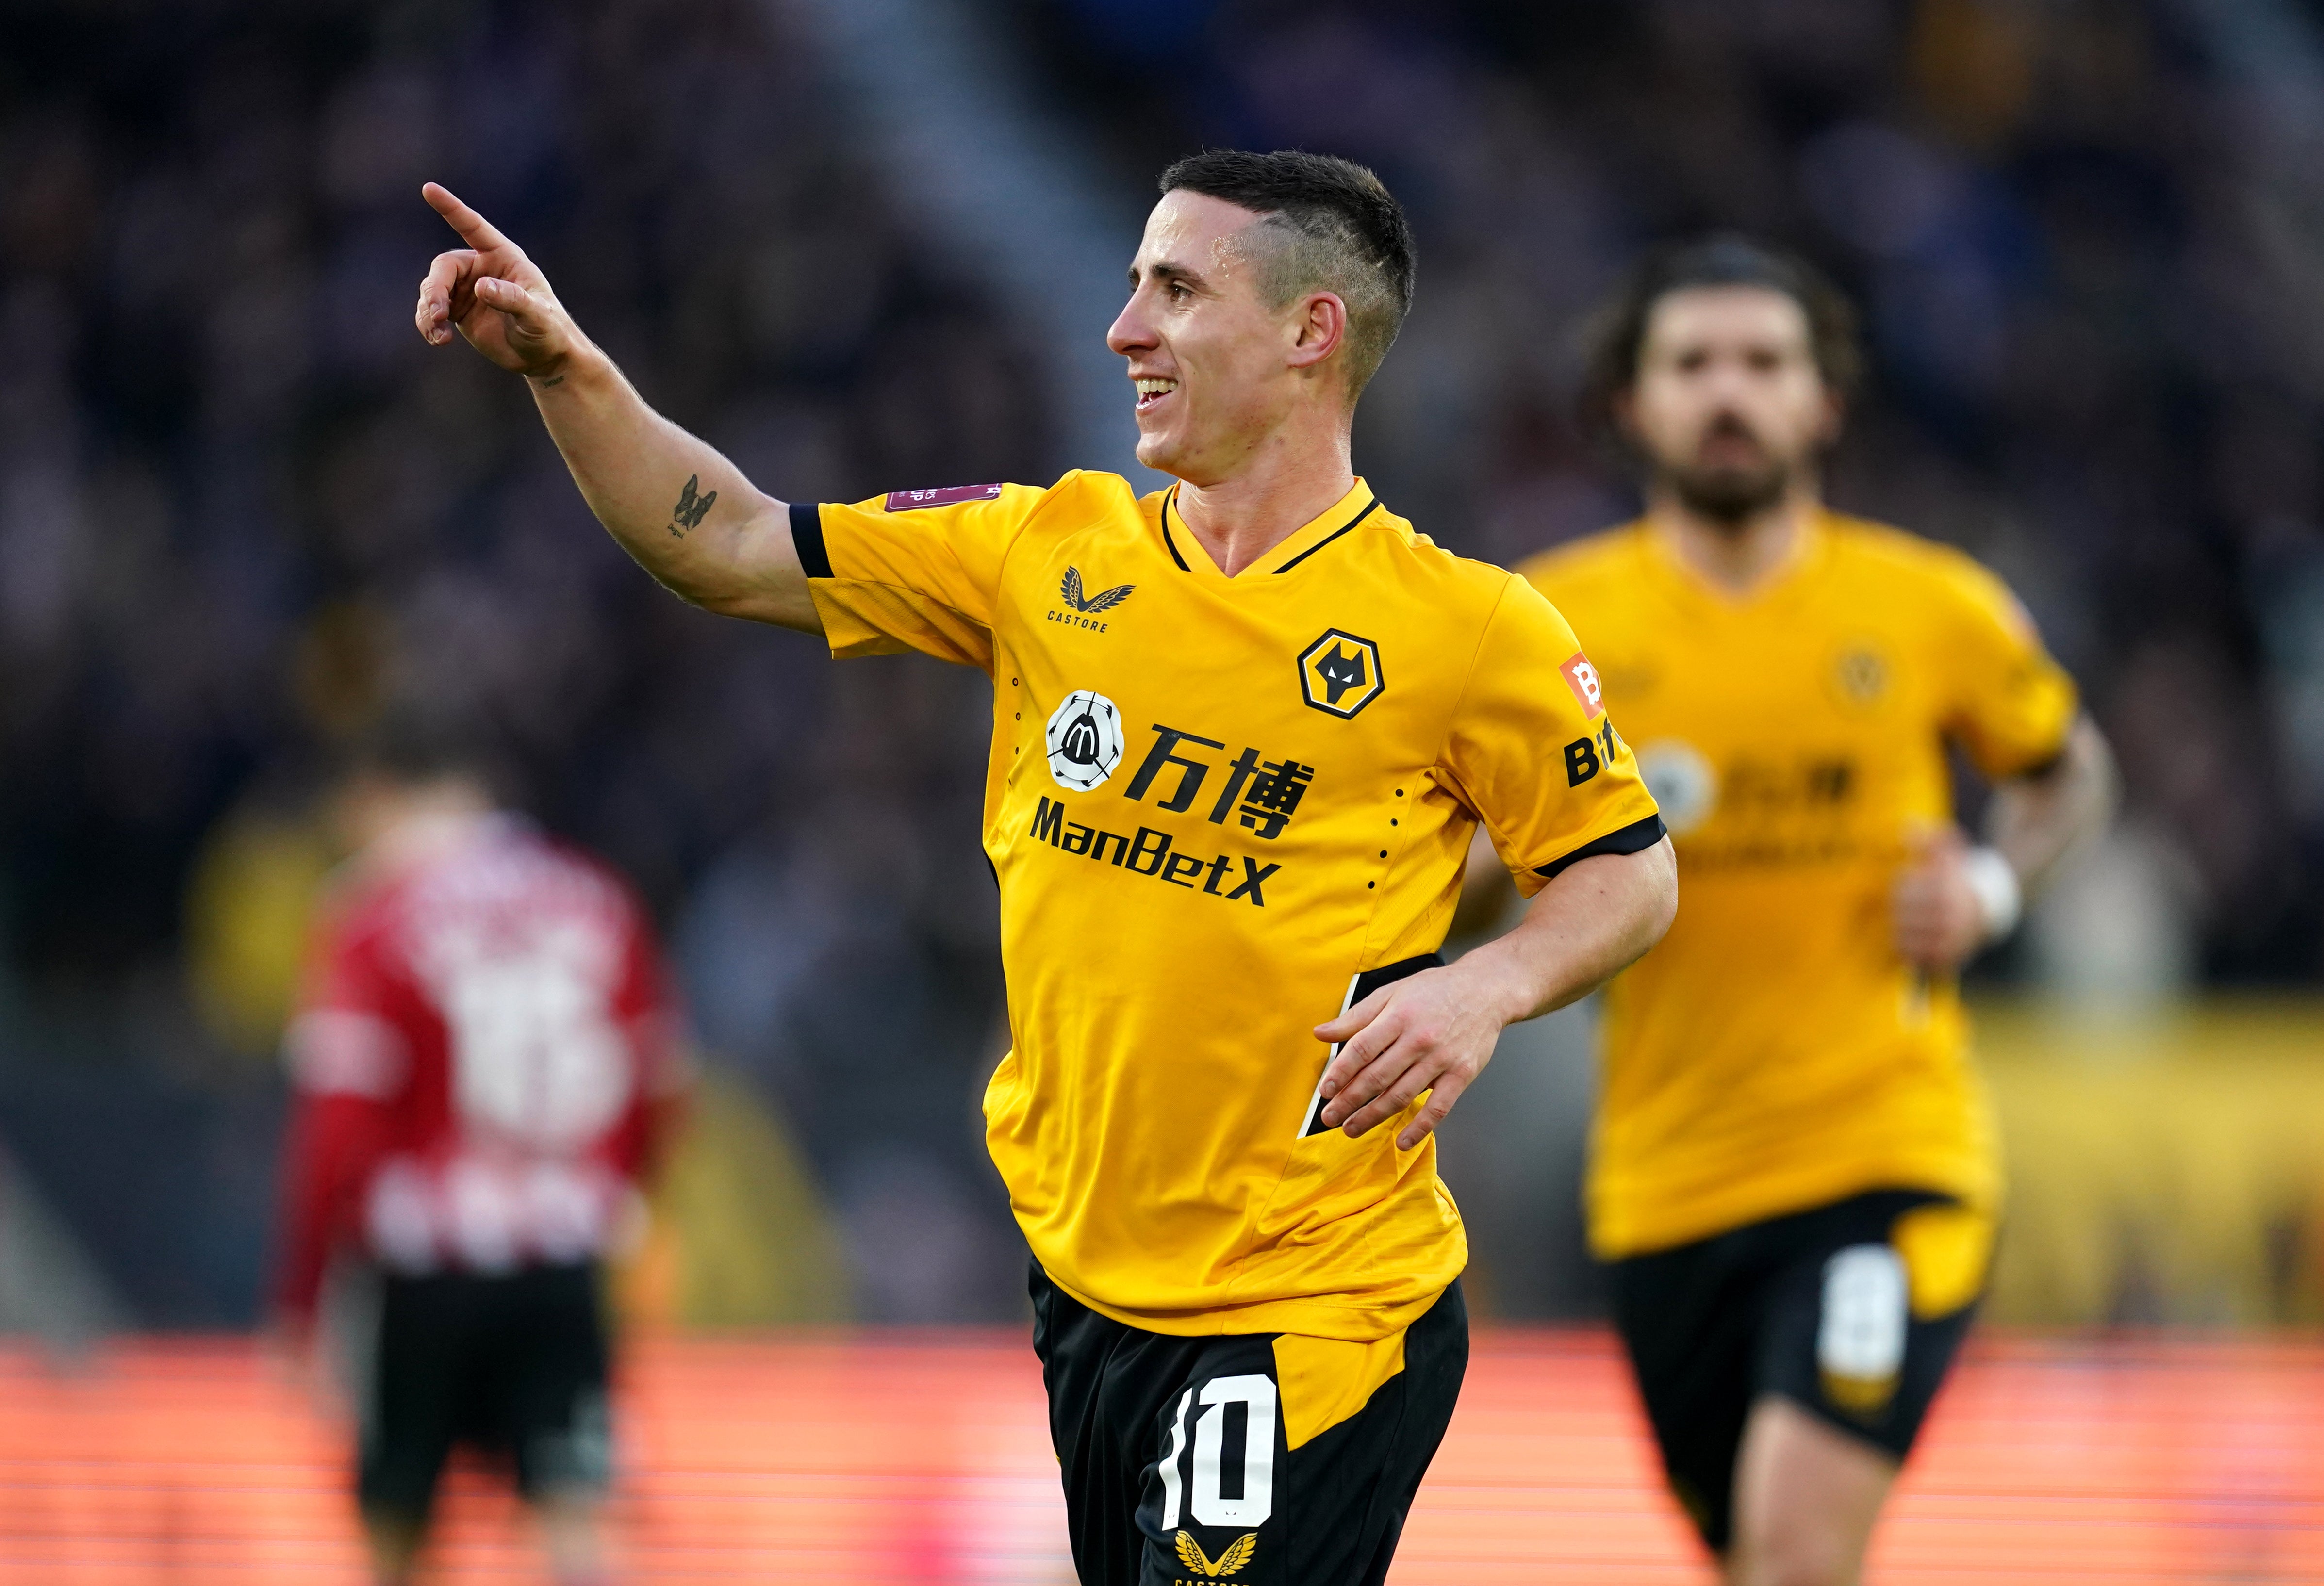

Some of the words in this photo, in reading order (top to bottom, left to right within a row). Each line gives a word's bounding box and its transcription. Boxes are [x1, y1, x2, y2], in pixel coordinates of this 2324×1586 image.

[1047, 610, 1108, 633] CASTORE
[1124, 723, 1315, 840] 万博
[1029, 796, 1282, 907] ManBetX
[1159, 1374, 1277, 1531] 10
